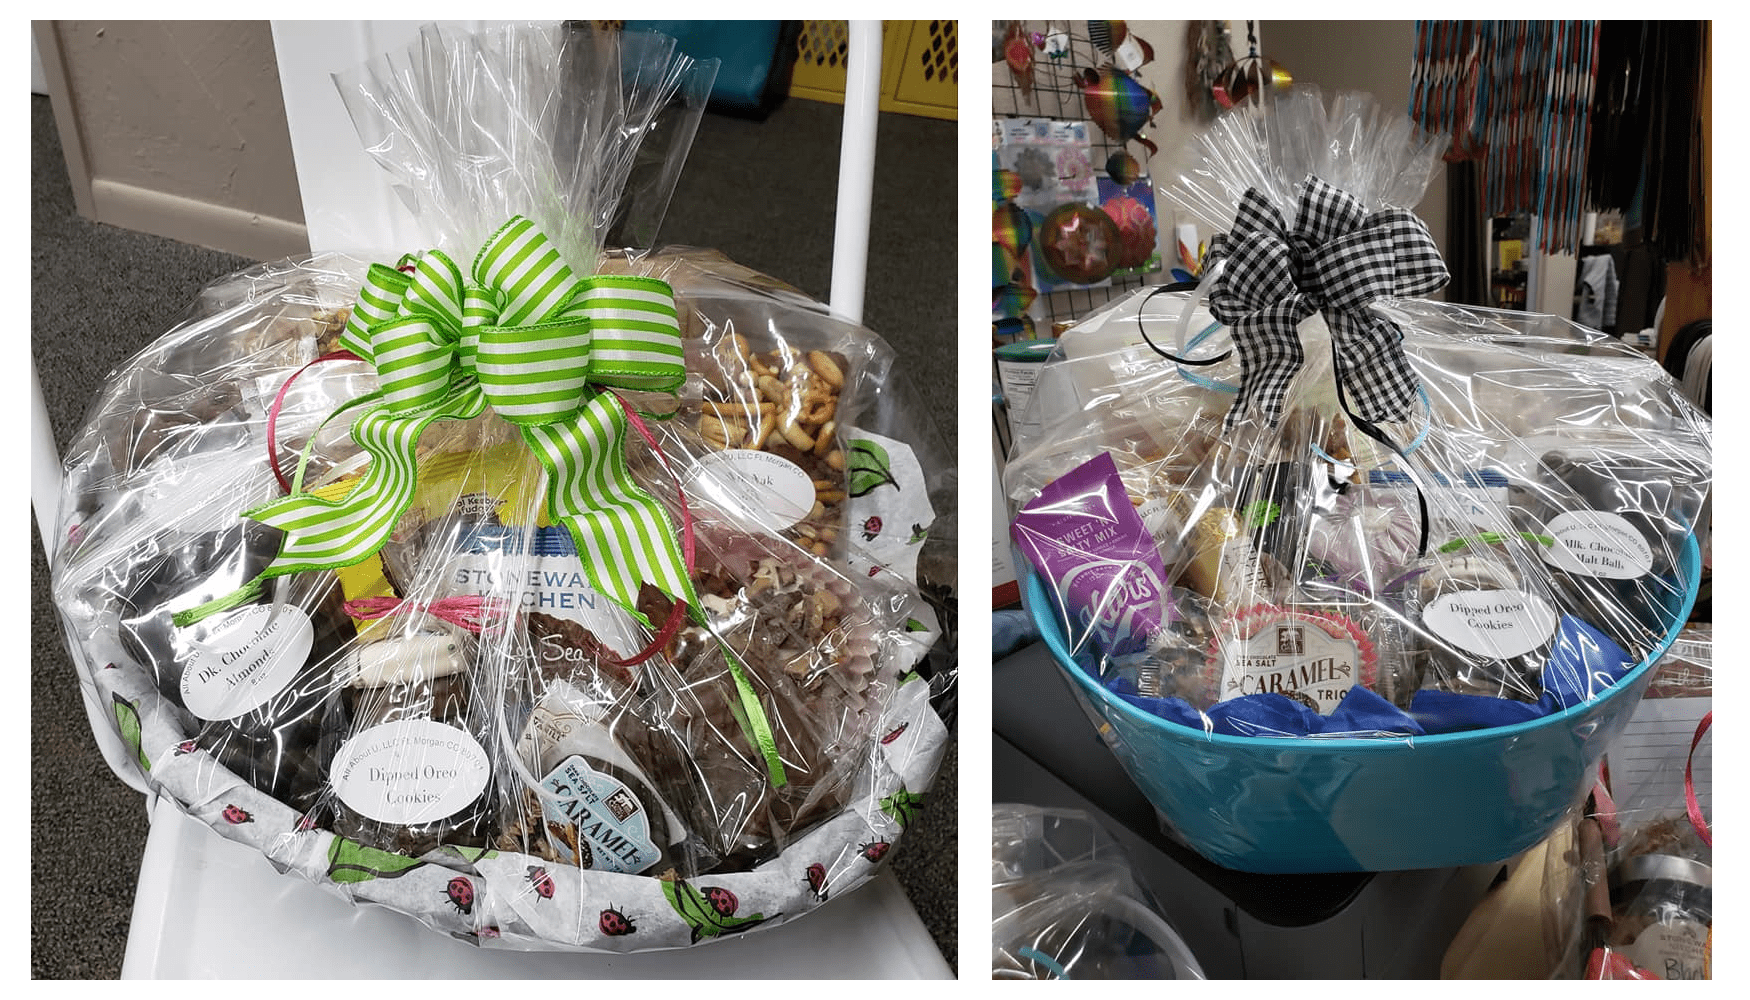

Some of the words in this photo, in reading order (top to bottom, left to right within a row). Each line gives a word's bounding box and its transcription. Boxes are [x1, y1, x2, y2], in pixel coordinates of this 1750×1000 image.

[1058, 538, 1092, 557] STY
[1094, 525, 1118, 544] MIX
[456, 569, 592, 589] STONEWA
[1450, 603, 1491, 617] Dipped
[1494, 603, 1525, 614] Oreo
[1467, 618, 1514, 630] Cookies
[540, 633, 591, 661] Sea
[1255, 659, 1277, 668] SALT
[198, 666, 222, 684] Dk.
[1239, 657, 1340, 696] CARAMEL
[413, 737, 445, 748] Morgan
[369, 767, 419, 786] Dipped
[423, 765, 457, 780] Oreo
[565, 767, 578, 785] SEA
[577, 784, 596, 805] SALT
[386, 789, 441, 805] Cookies
[555, 784, 638, 866] CARAMEL
